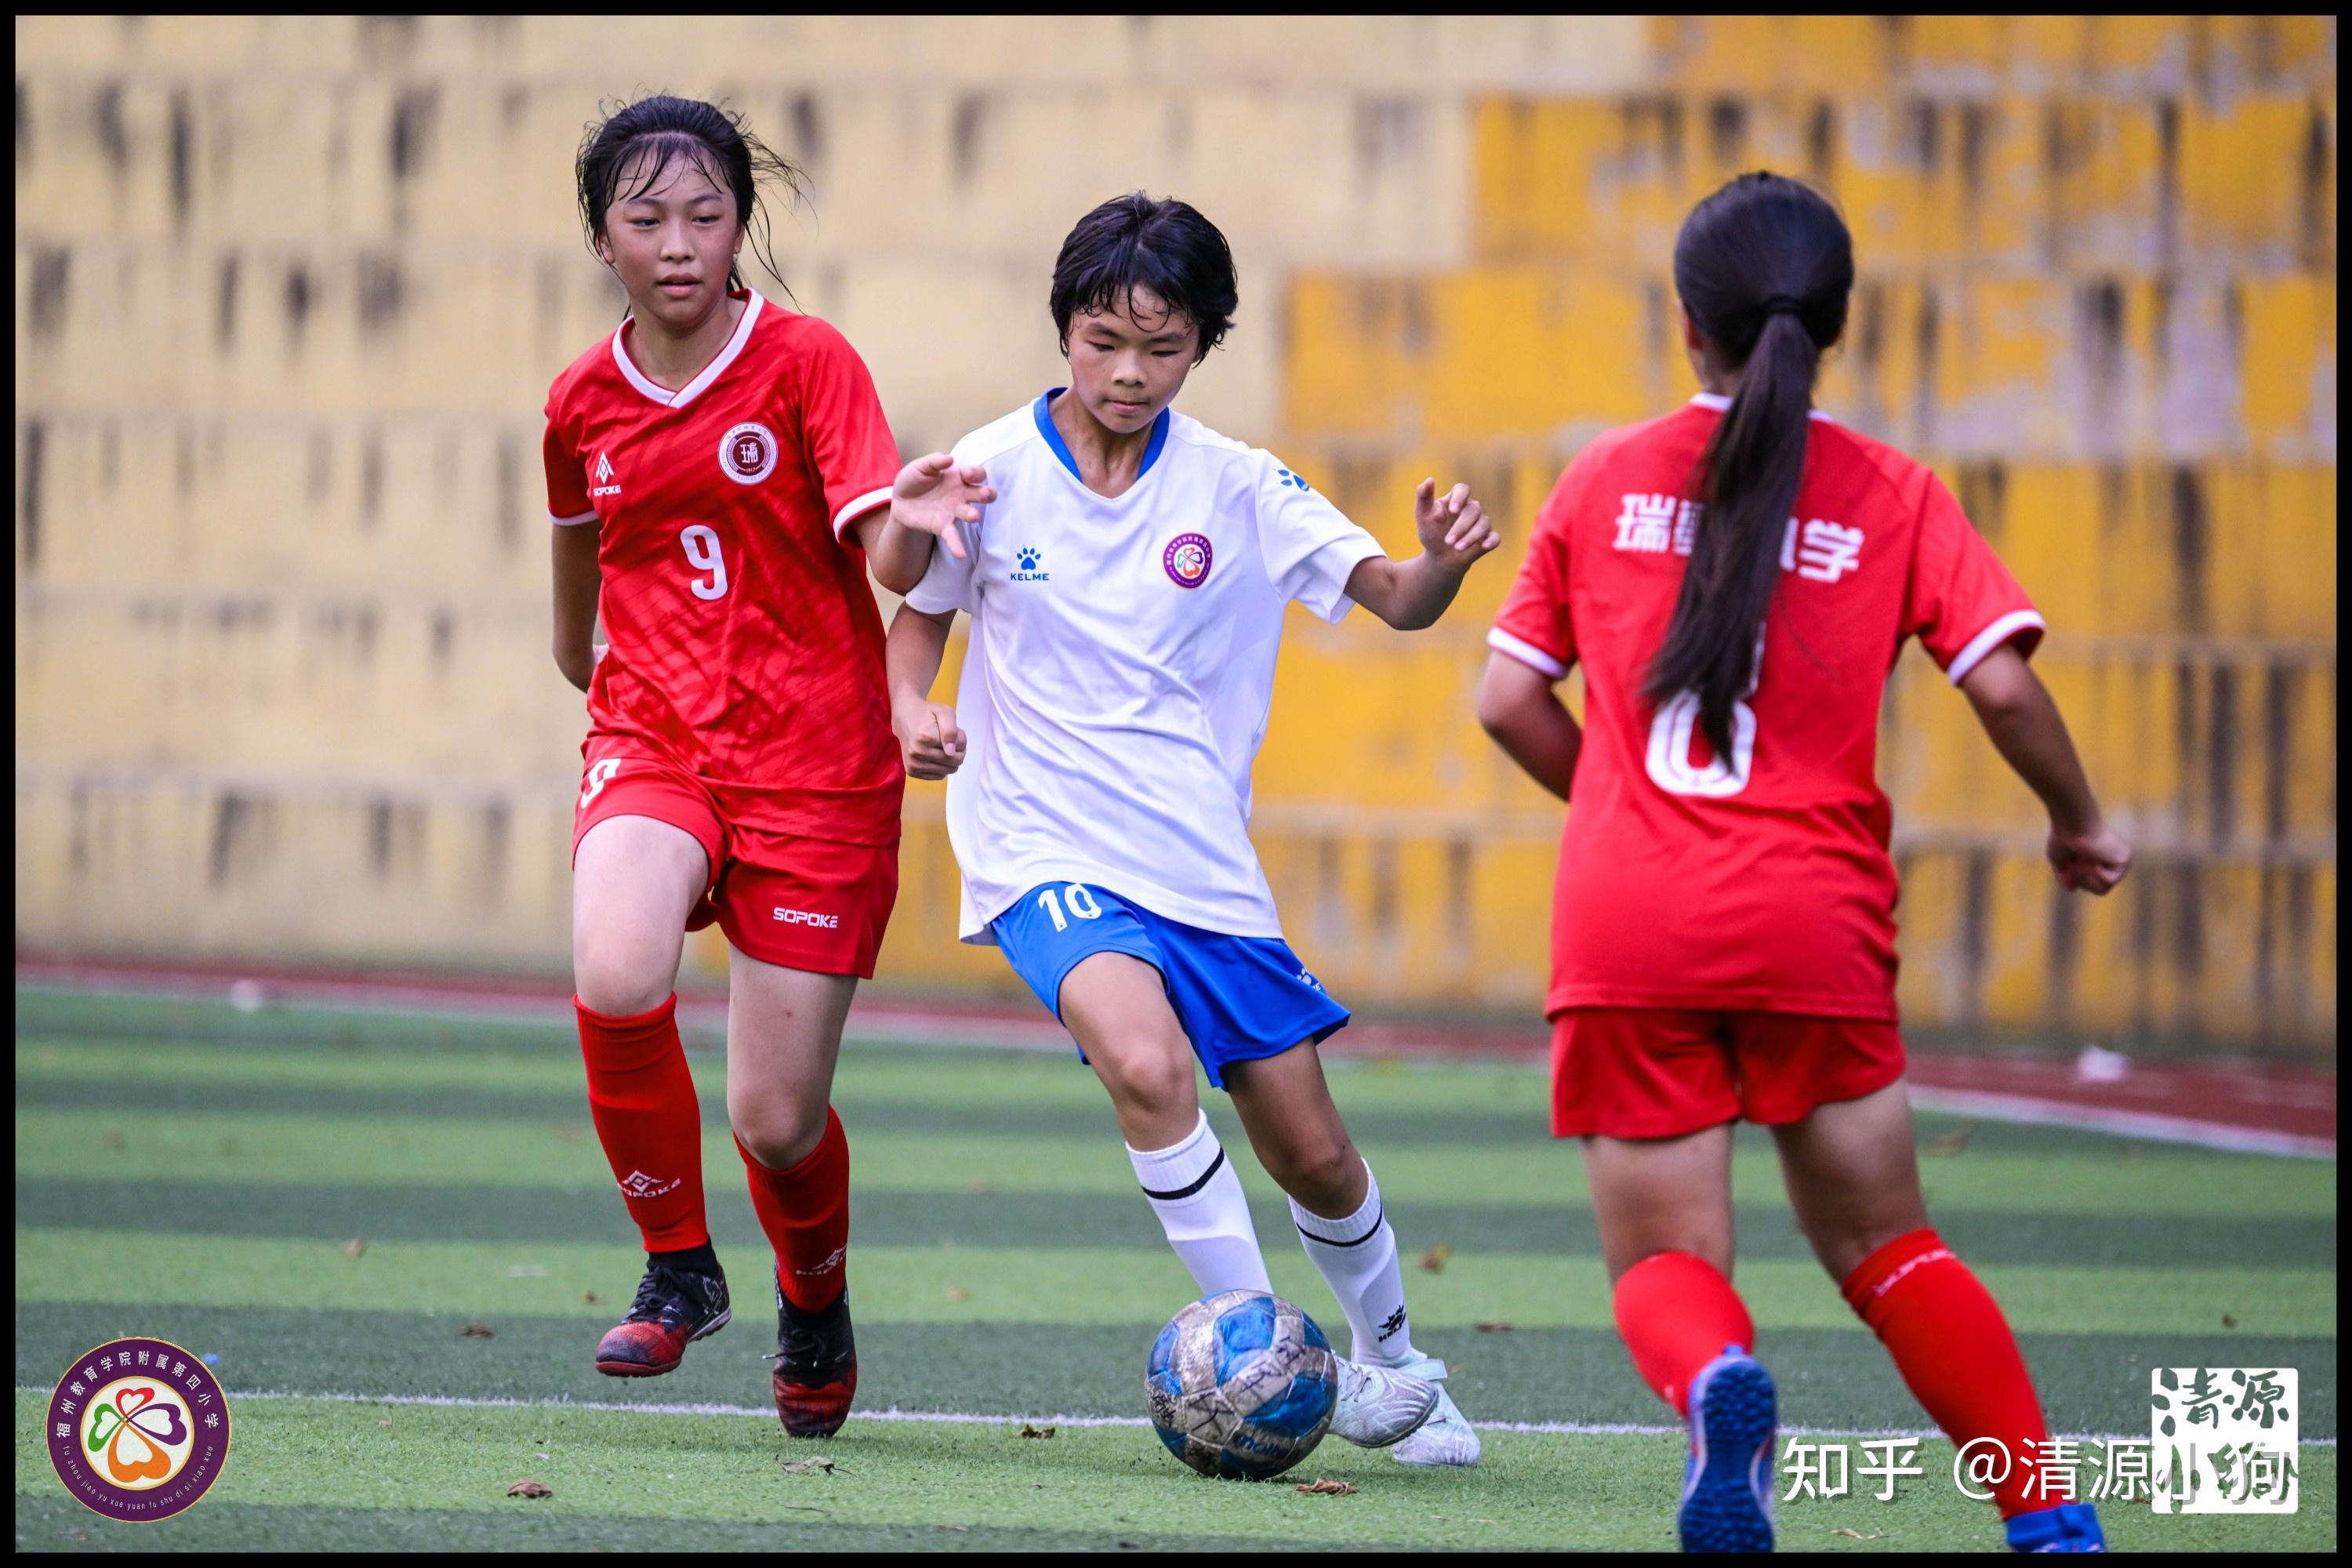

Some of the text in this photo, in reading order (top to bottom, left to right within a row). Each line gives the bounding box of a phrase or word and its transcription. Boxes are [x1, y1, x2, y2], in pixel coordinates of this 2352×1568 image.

[593, 485, 622, 497] SOPOKE
[680, 524, 728, 601] 9
[1613, 493, 1865, 583] 瑞学
[772, 906, 839, 928] SOPOKE
[1037, 883, 1102, 932] 10
